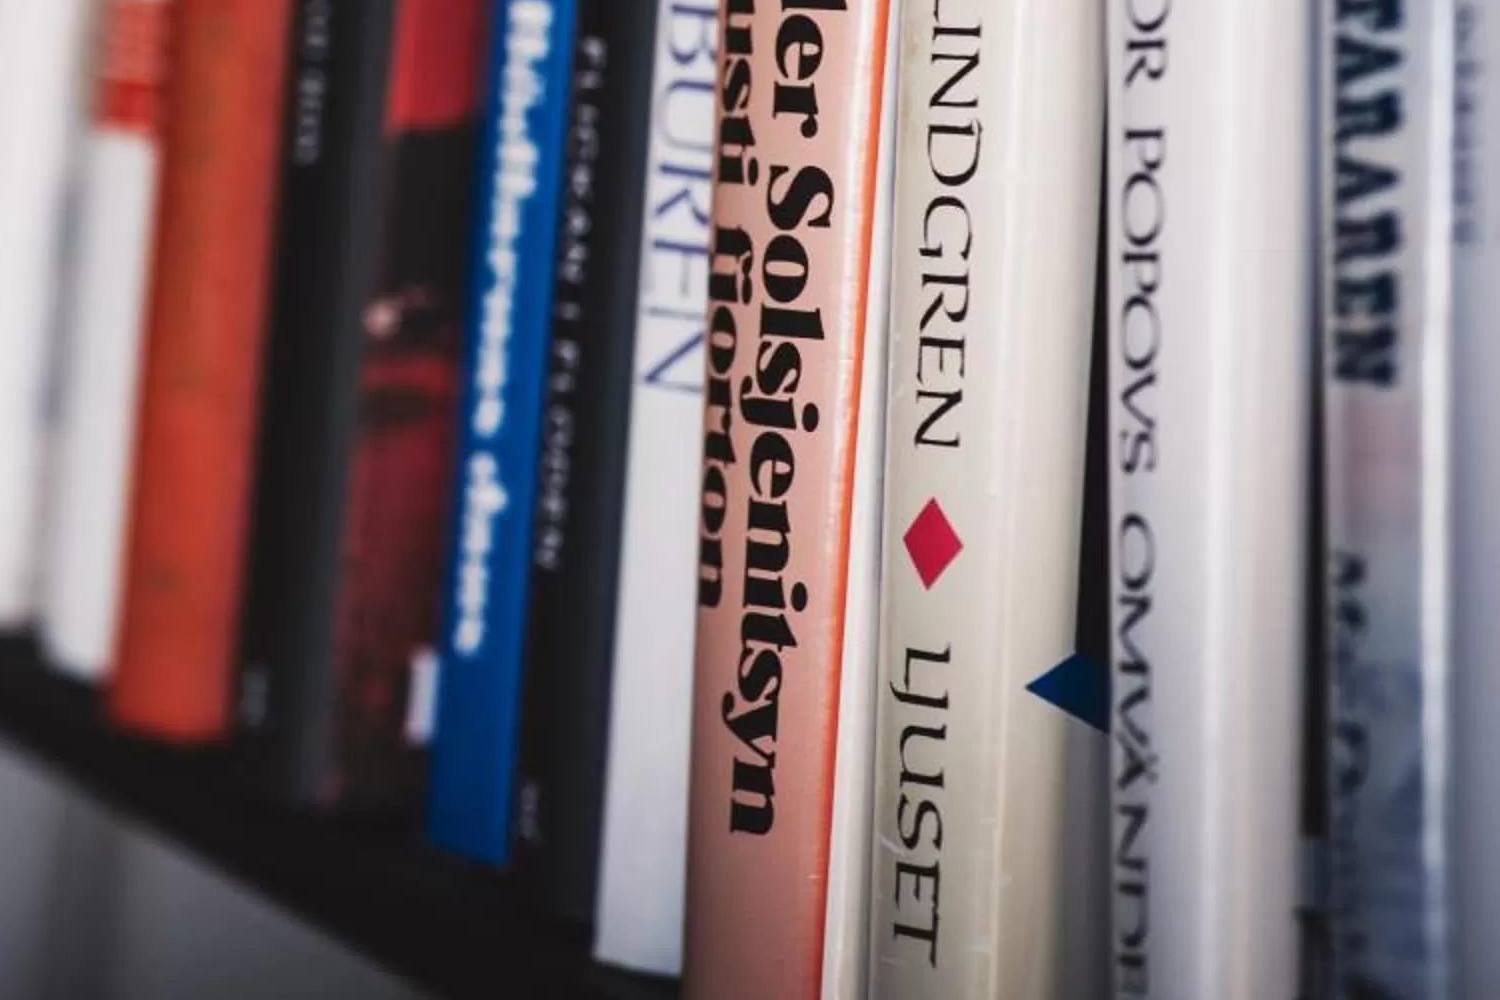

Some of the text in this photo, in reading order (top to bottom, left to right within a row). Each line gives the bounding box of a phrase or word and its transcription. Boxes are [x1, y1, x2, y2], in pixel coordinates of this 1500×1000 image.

[1119, 126, 1167, 475] POPOVS
[721, 166, 834, 835] Solsjenitsyn
[890, 645, 952, 967] LJUSET
